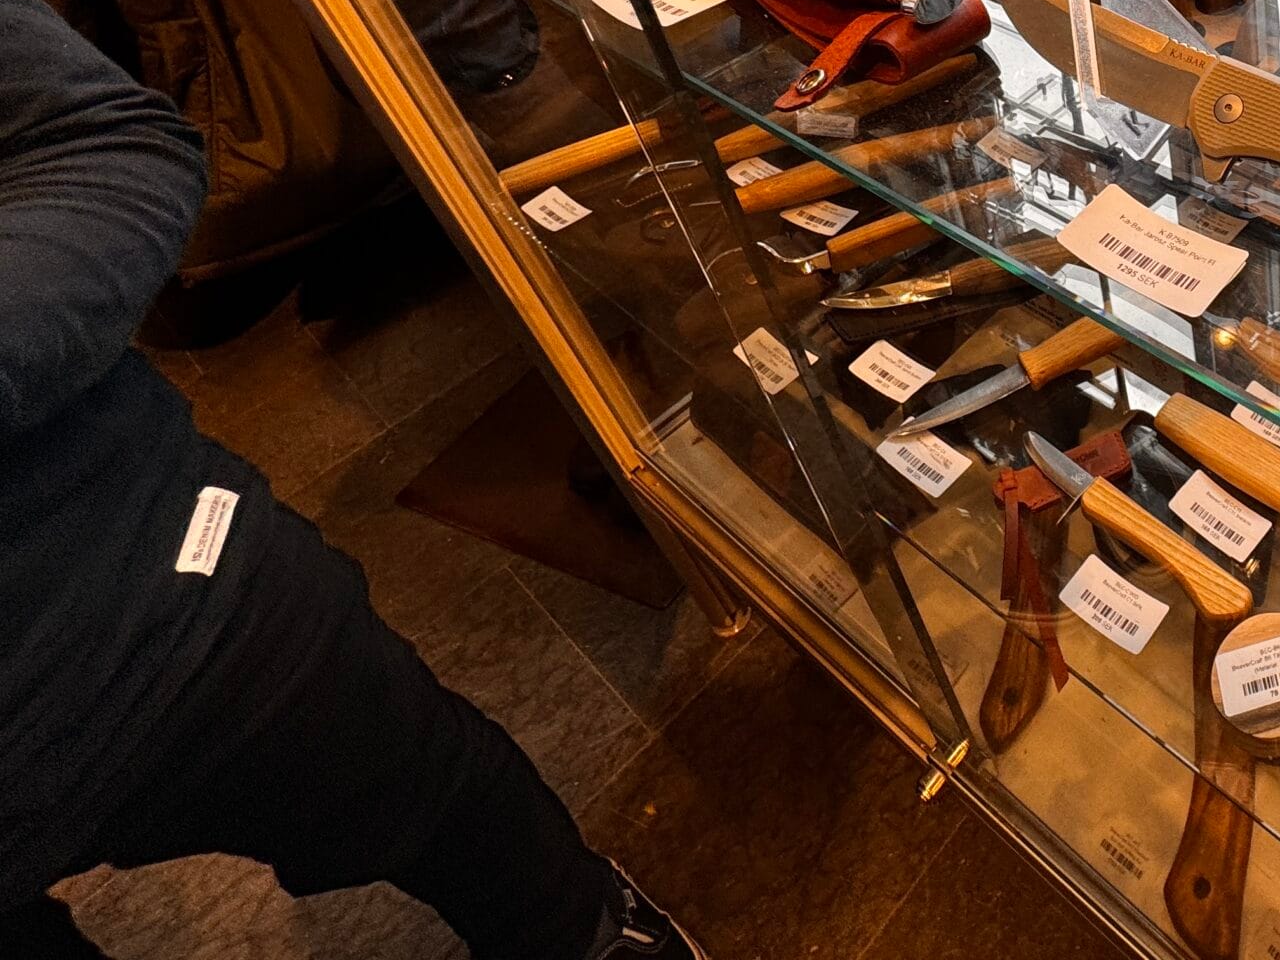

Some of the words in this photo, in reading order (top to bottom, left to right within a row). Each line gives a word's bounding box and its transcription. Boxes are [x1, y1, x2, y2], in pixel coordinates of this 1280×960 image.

[1169, 46, 1207, 70] KA-BAR
[1116, 263, 1137, 278] 1295
[1137, 274, 1160, 289] SEK
